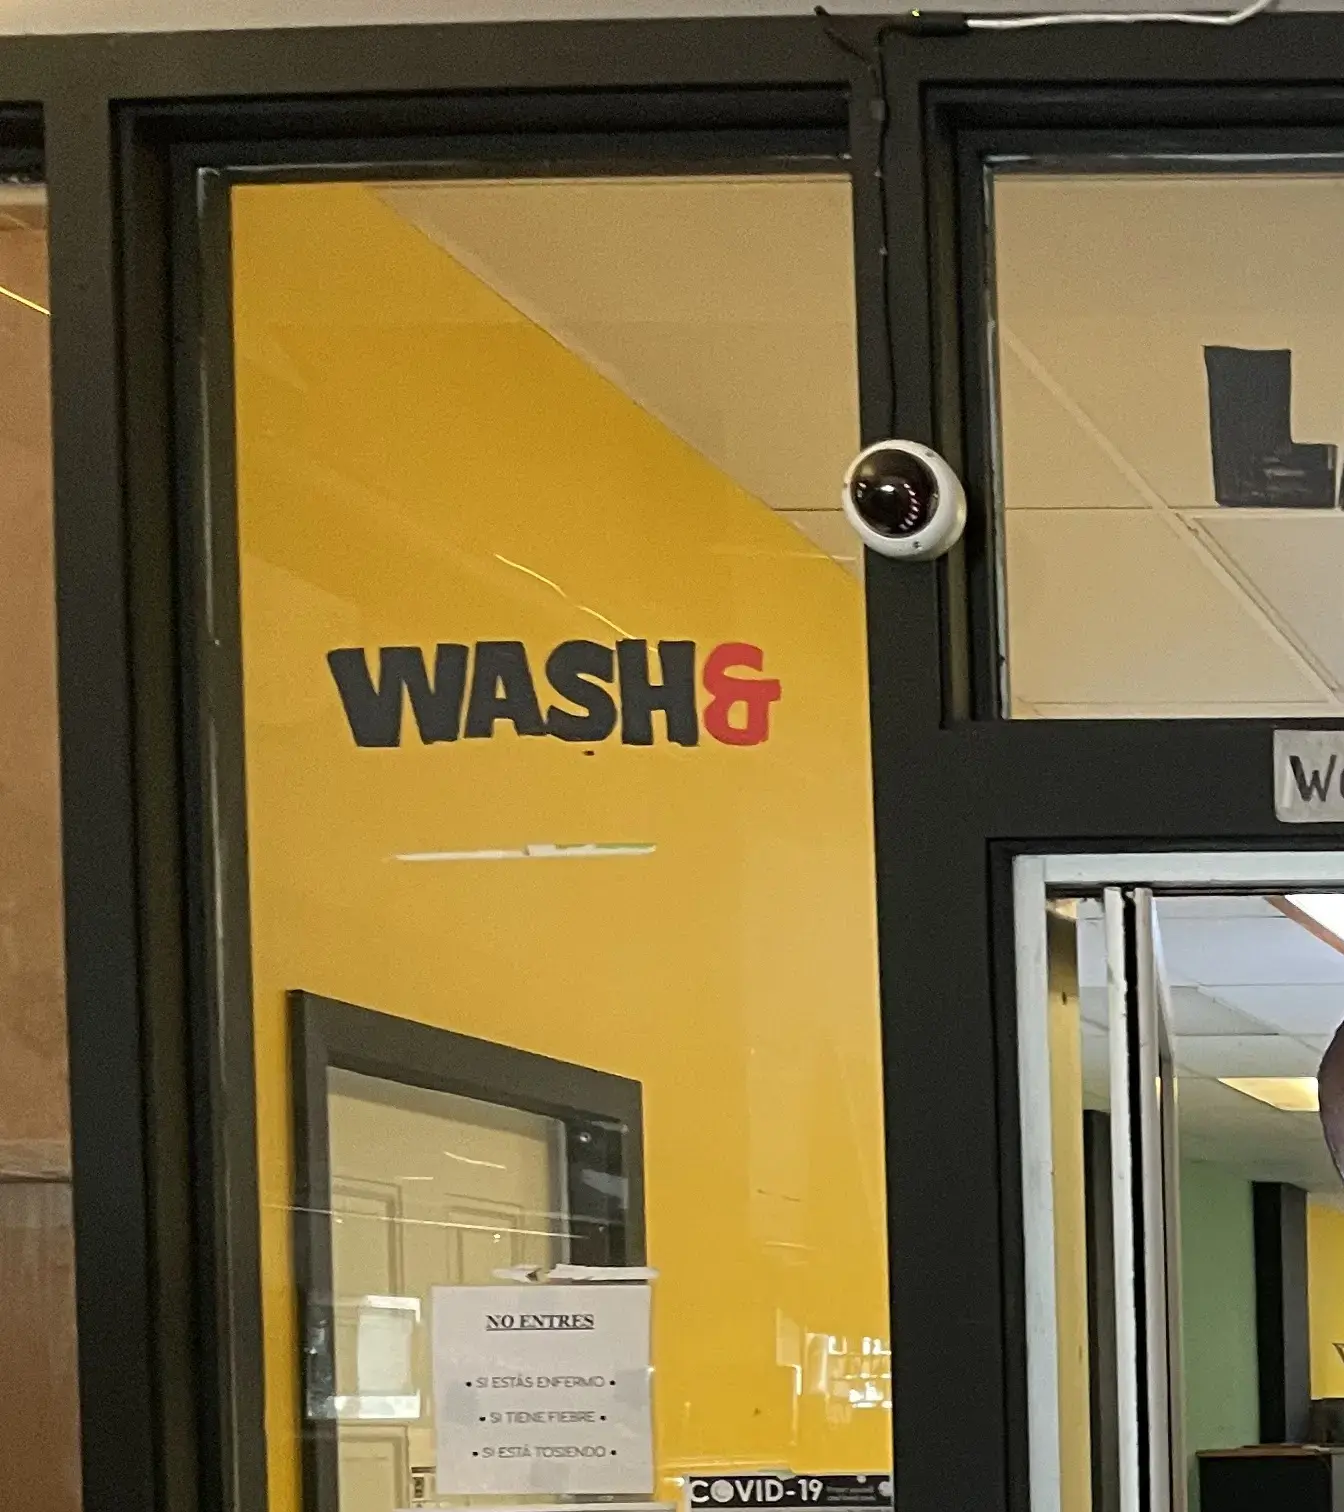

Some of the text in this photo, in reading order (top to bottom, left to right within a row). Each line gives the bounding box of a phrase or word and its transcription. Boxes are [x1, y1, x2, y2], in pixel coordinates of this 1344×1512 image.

[486, 1313, 595, 1329] NO ENTRES
[690, 1478, 824, 1503] COVID-19
